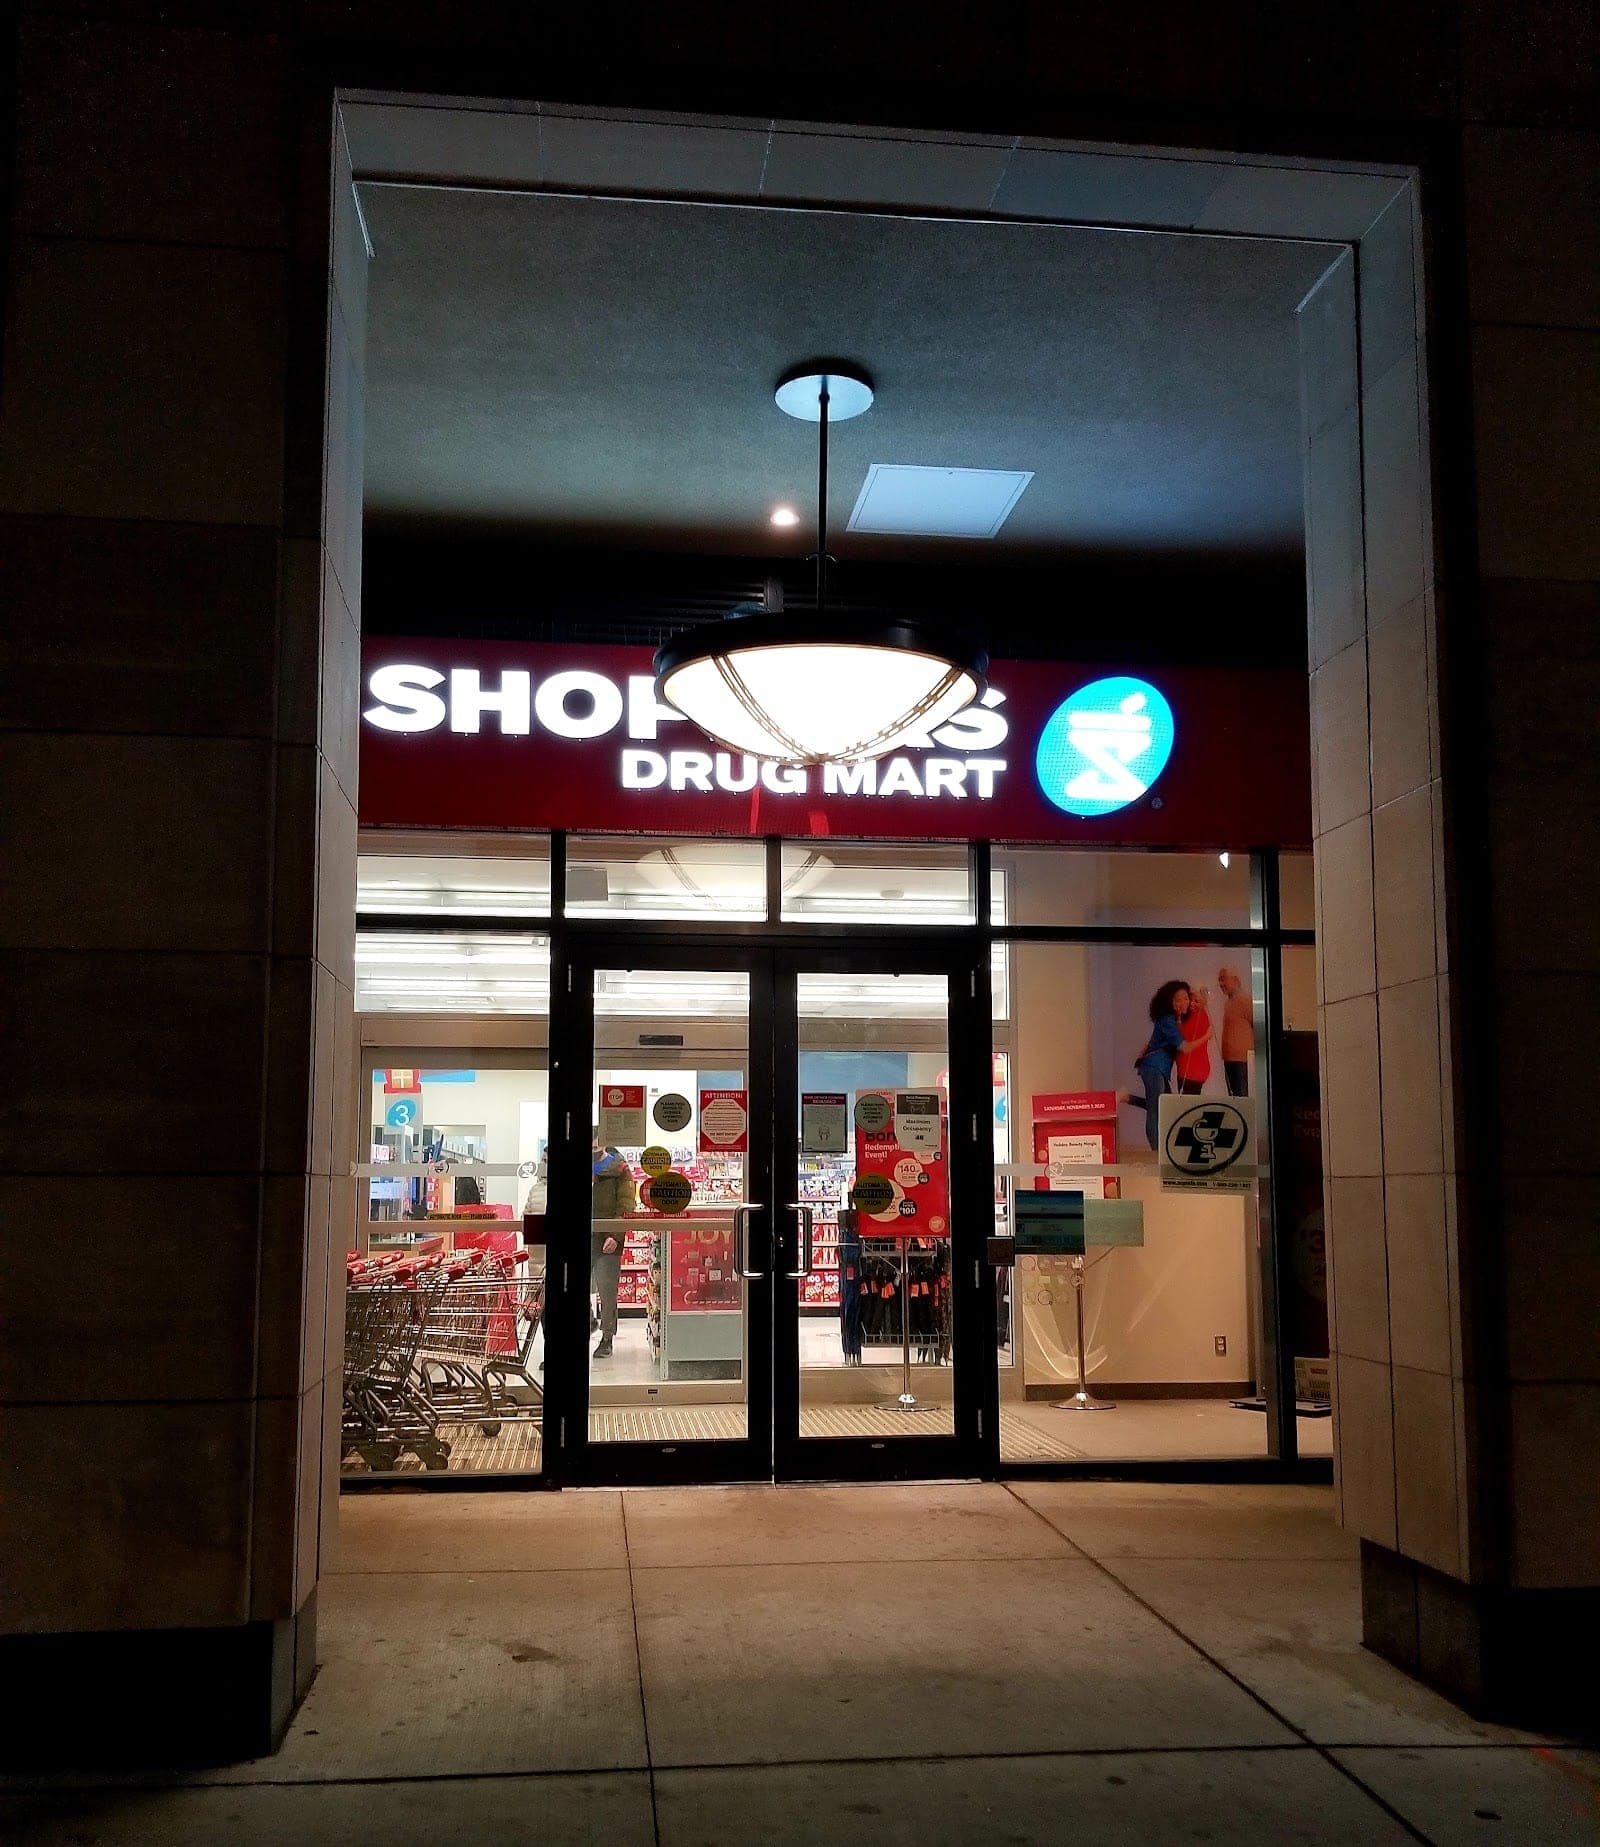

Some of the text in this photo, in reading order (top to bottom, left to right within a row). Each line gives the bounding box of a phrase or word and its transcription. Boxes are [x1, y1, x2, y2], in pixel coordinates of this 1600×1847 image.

[362, 664, 1009, 752] SHOPS
[622, 749, 1007, 799] DRUG MART
[395, 1104, 410, 1126] 3
[864, 1143, 900, 1152] Redempti
[651, 1189, 691, 1198] CAUTION
[853, 1190, 892, 1198] CAUTION
[685, 1230, 733, 1245] JOY
